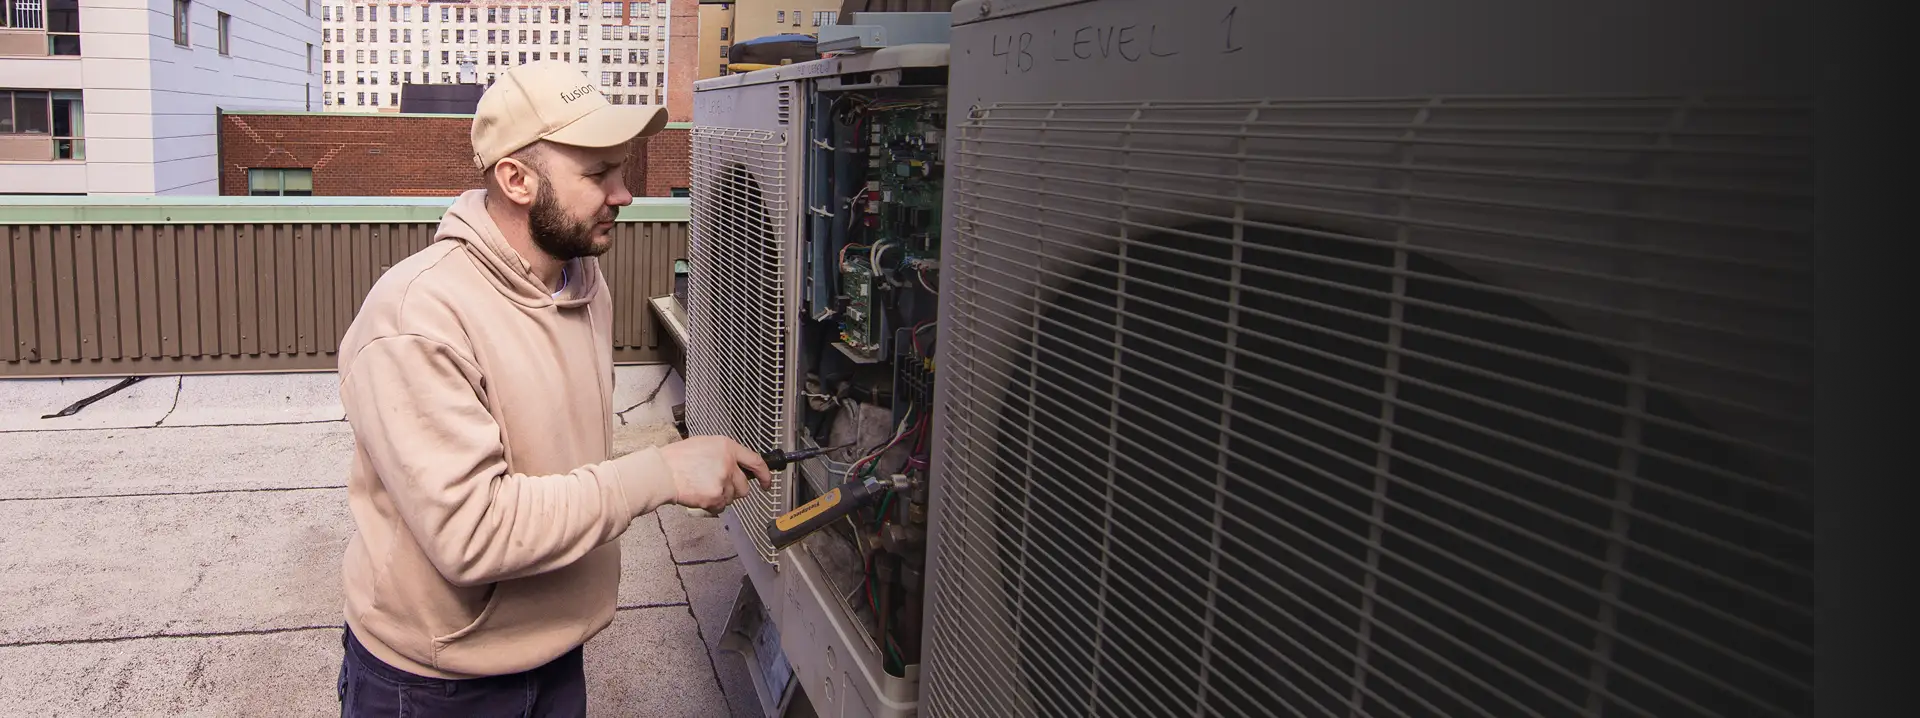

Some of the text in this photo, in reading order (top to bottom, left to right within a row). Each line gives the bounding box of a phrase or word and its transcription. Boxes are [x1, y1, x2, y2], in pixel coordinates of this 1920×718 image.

[991, 6, 1243, 75] 4B LEVEL 1
[559, 83, 596, 104] fusion
[789, 500, 820, 520] Fieldpiece
